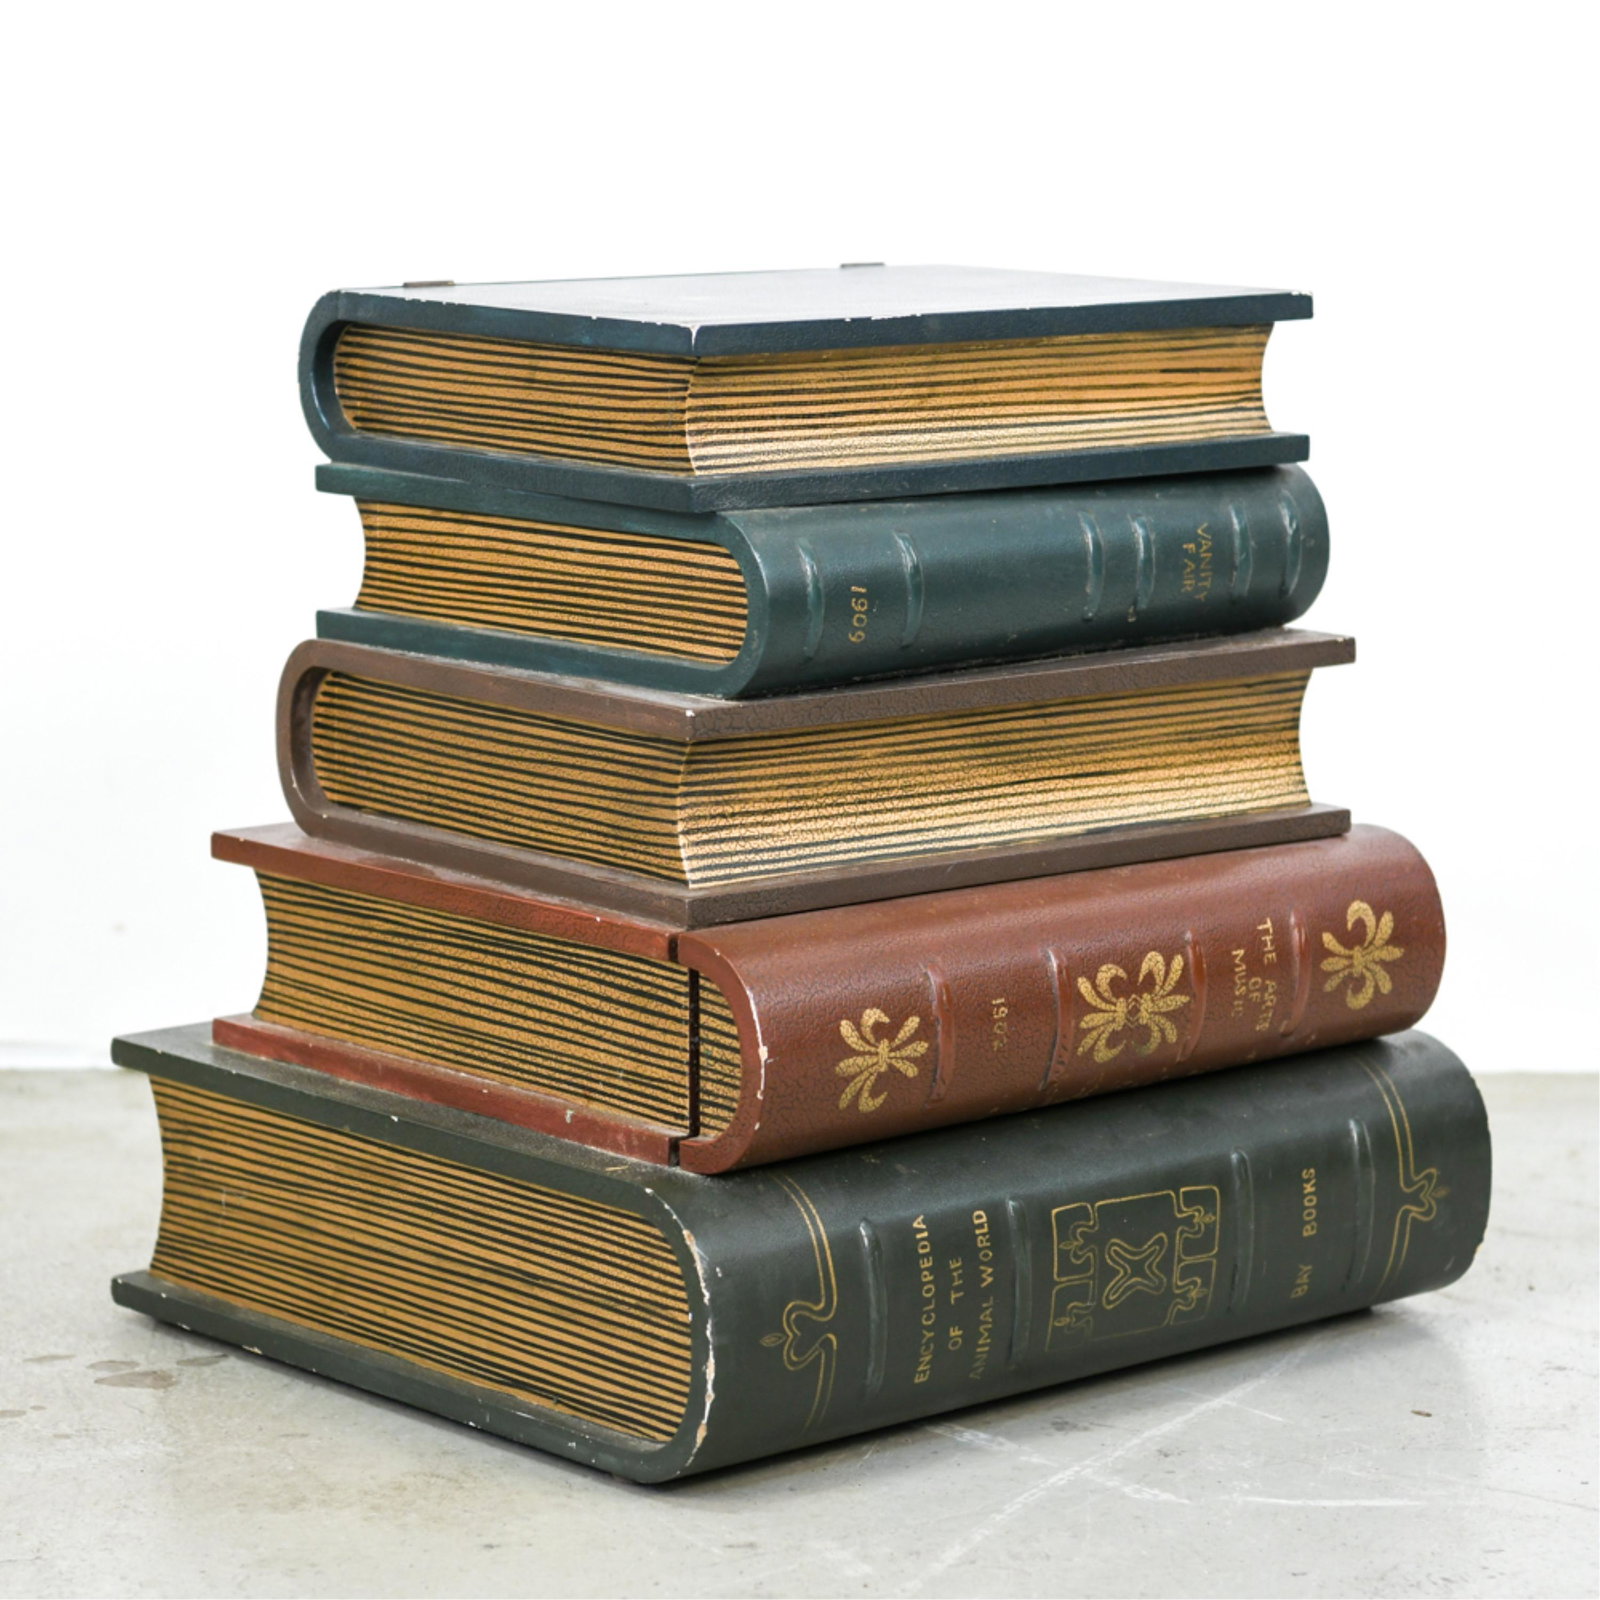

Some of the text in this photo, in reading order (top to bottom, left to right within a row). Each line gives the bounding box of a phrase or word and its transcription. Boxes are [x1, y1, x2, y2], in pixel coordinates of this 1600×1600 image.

[1181, 543, 1197, 592] FAIR
[1194, 522, 1213, 602] VANITY
[849, 585, 868, 644] 1909
[1256, 917, 1277, 965] THE
[1248, 976, 1262, 1003] OF
[1301, 1167, 1318, 1237] BOOKS
[912, 1214, 936, 1384] ENCYCLOPEDIA
[948, 1256, 965, 1351] OF THE
[969, 1209, 994, 1379] ANIMAL WORLD
